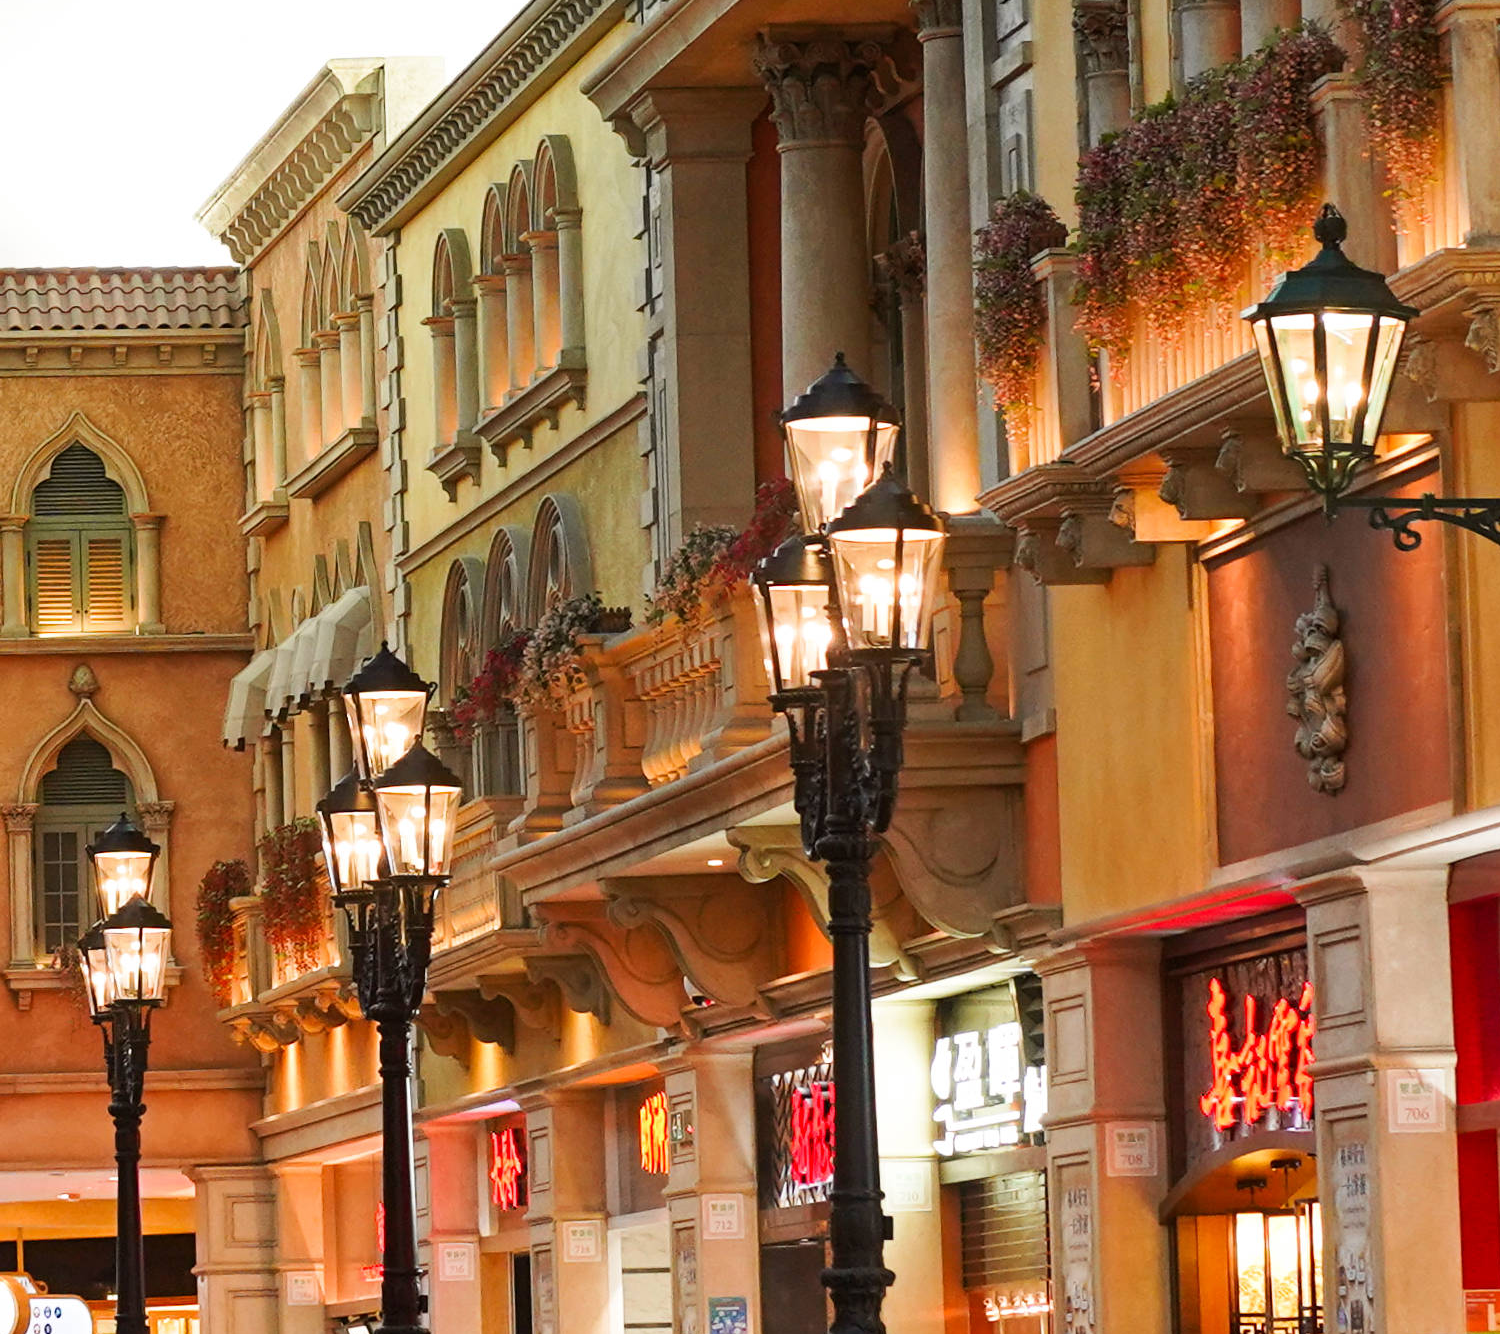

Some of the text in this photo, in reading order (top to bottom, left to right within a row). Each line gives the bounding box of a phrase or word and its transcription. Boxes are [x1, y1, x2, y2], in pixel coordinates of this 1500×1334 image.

[1405, 1107, 1430, 1121] 706
[1120, 1153, 1143, 1165] 708
[715, 1219, 733, 1231] 712
